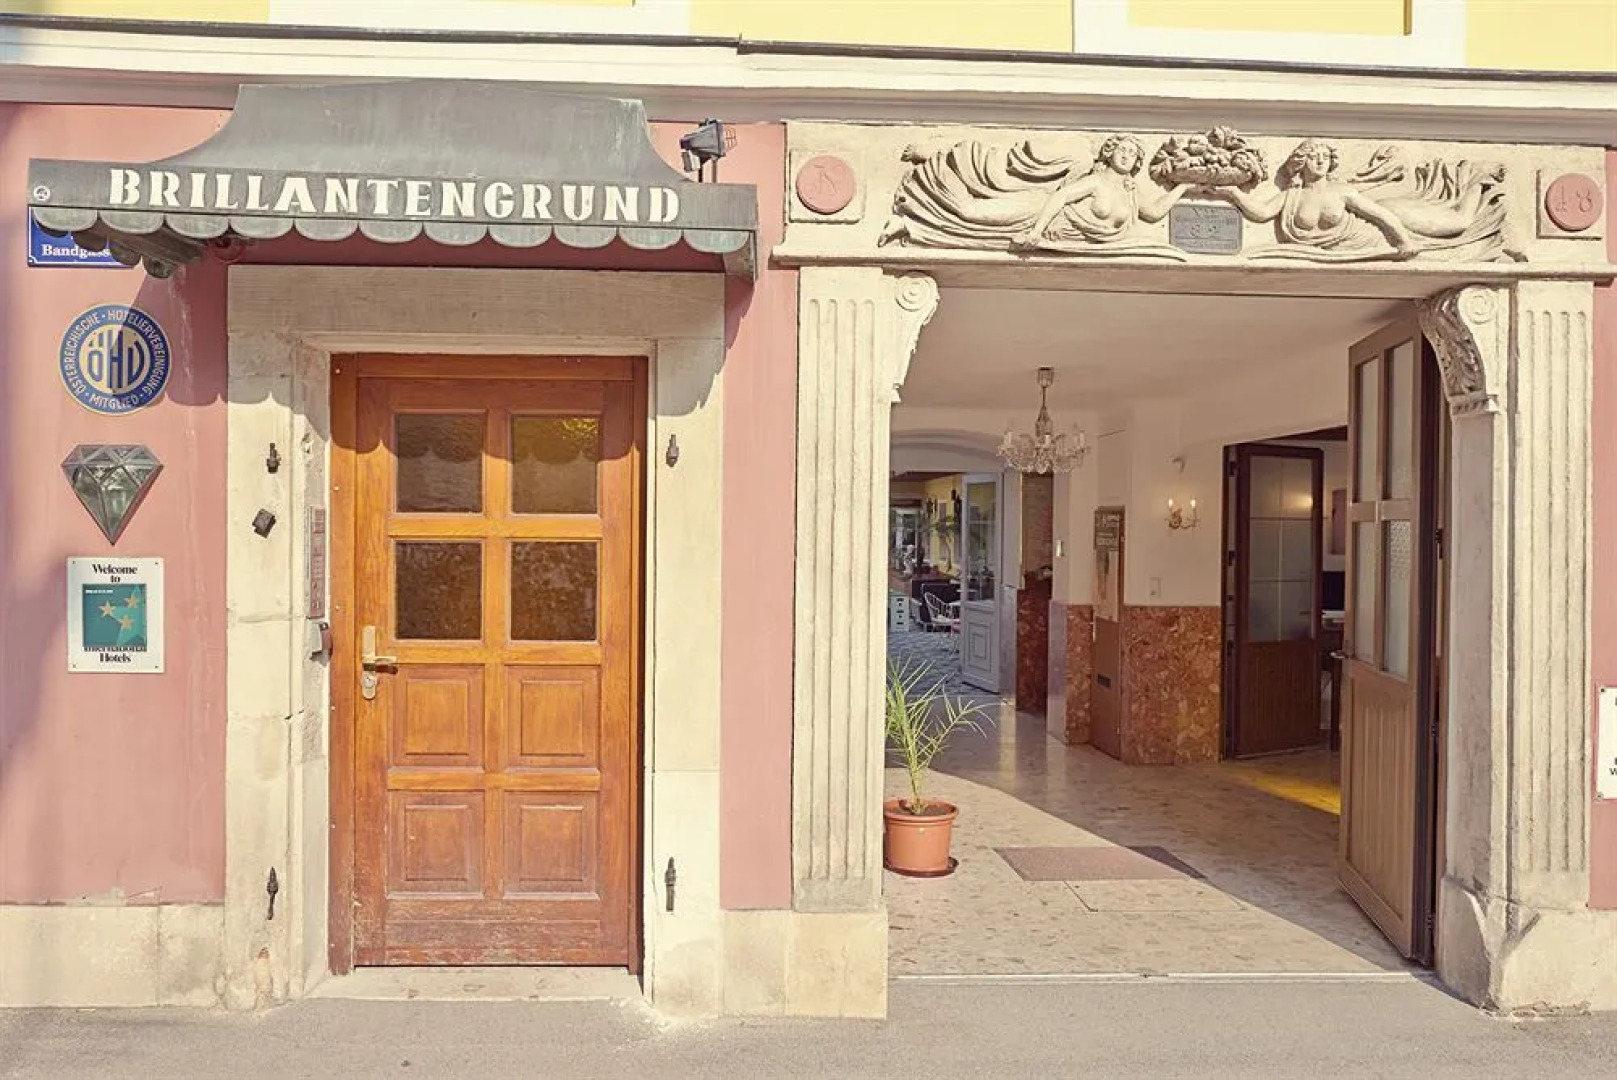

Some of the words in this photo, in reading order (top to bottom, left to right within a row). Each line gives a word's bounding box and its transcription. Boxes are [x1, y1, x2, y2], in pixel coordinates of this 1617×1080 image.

[108, 167, 682, 225] BRILLANTENGRUND
[88, 393, 140, 411] MITGLIED
[92, 563, 138, 575] Welcome
[109, 574, 121, 583] to
[99, 653, 132, 663] Hotels
